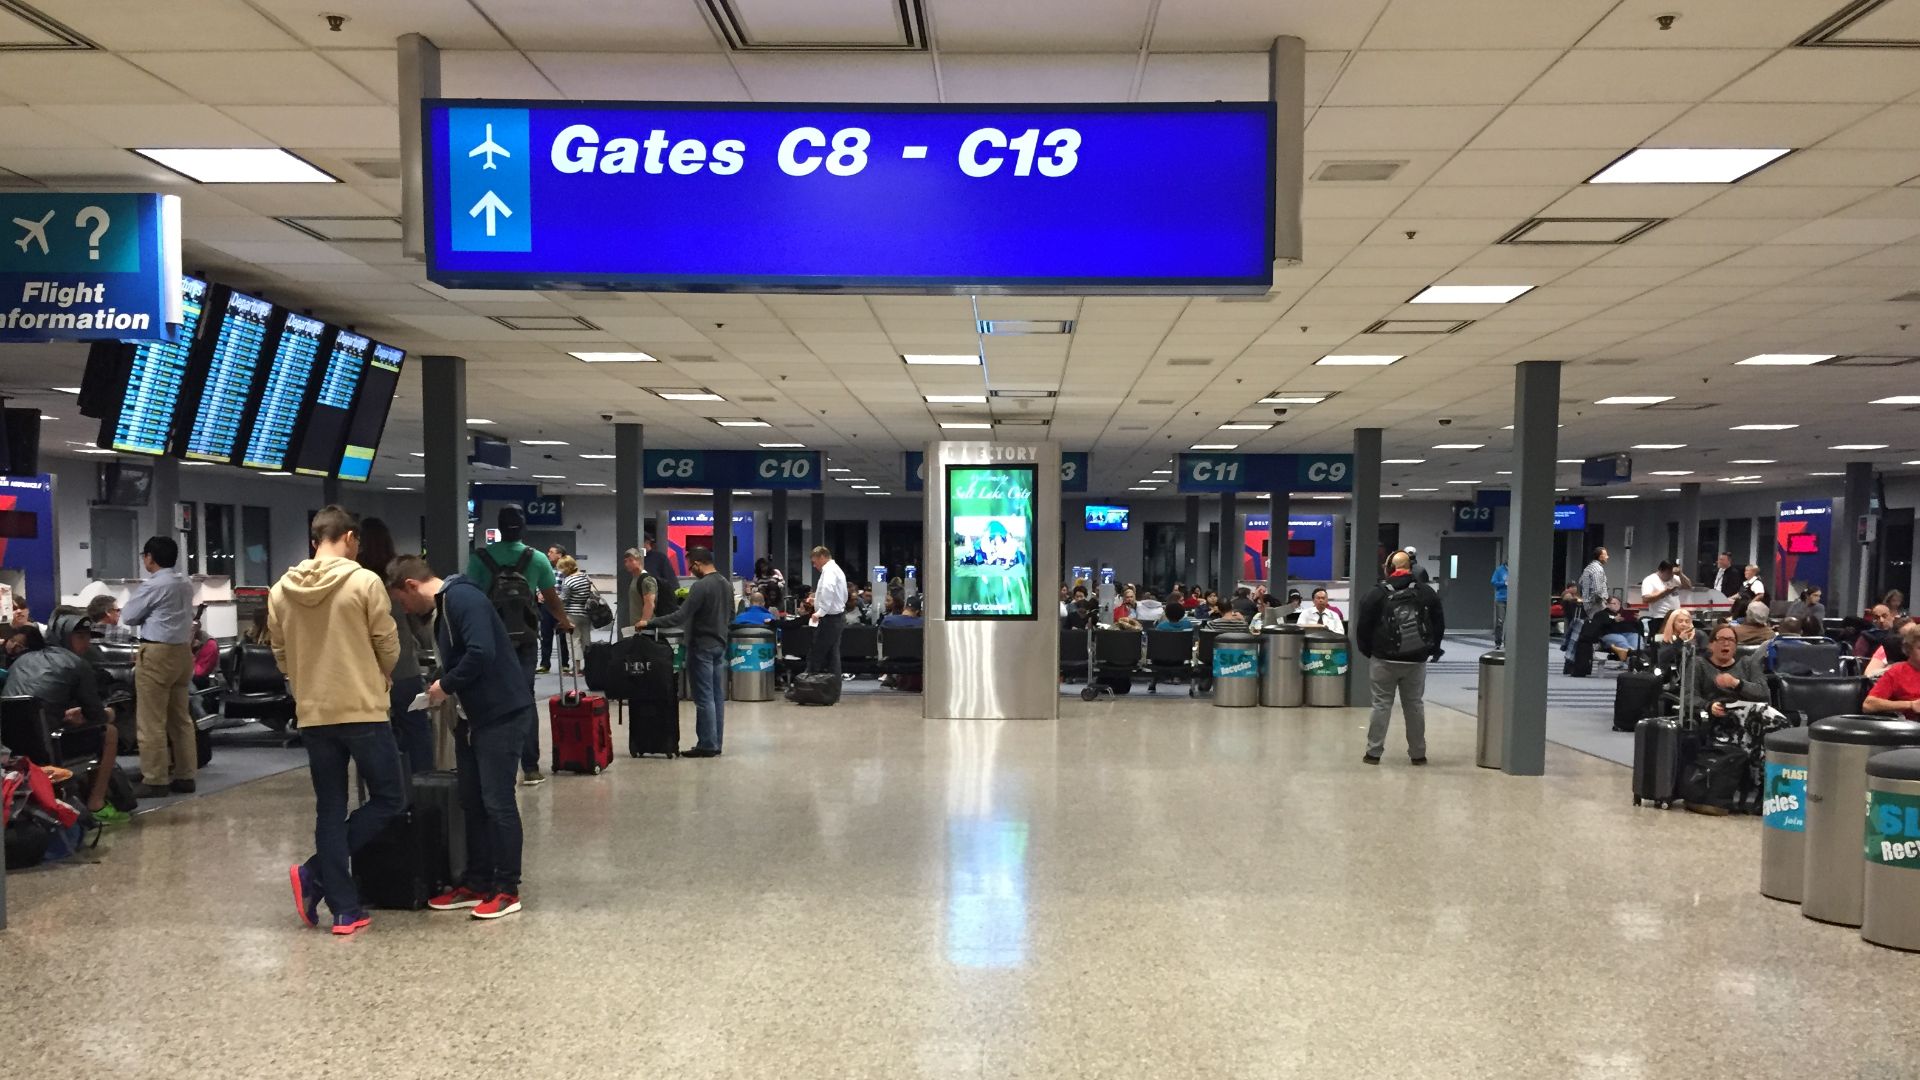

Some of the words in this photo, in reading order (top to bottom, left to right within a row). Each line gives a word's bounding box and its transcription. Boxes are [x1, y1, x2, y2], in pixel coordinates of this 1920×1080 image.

[551, 124, 746, 176] Gates
[777, 127, 871, 176] C8
[958, 127, 1082, 178] C13
[22, 281, 105, 308] Flight
[656, 458, 694, 478] C8
[759, 458, 810, 478] C10
[1192, 462, 1239, 481] C11
[1308, 462, 1346, 482] C9
[527, 502, 556, 515] C12
[1460, 507, 1491, 520] C13
